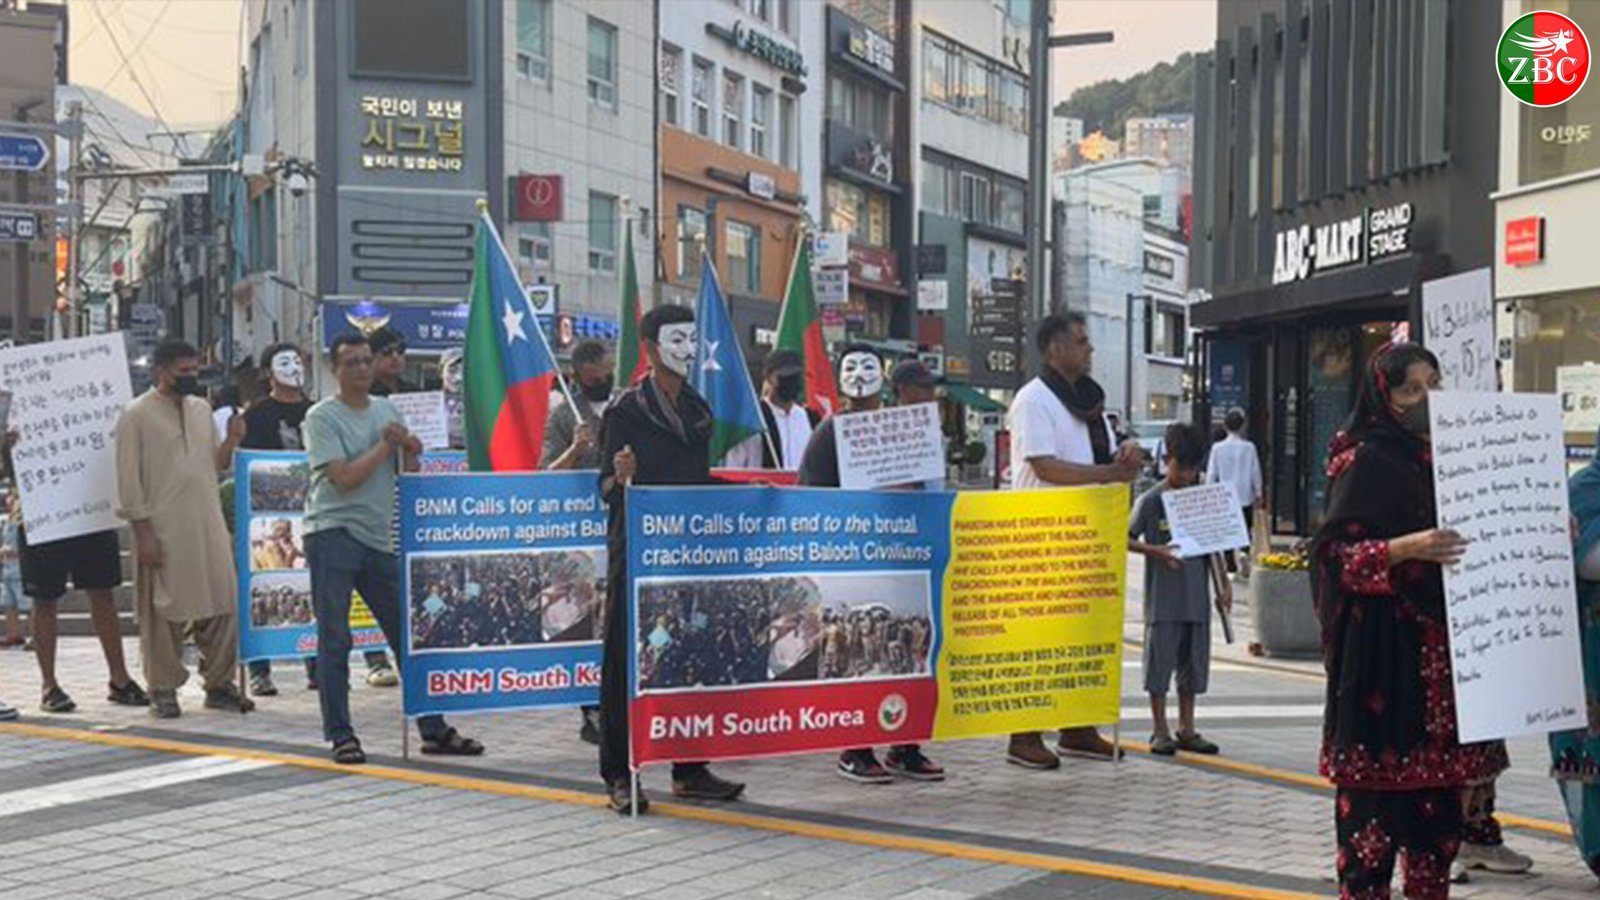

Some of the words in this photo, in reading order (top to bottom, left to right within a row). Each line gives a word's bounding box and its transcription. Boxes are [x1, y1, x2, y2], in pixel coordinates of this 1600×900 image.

[426, 99, 462, 119] 보낸
[362, 119, 463, 155] 시그널
[1370, 202, 1412, 233] GRAND
[1369, 228, 1408, 257] STAGE
[415, 498, 457, 517] BNM
[461, 496, 504, 516] Calls
[510, 496, 533, 514] for
[538, 499, 559, 513] an
[563, 494, 595, 512] end
[414, 523, 510, 544] crackdown
[513, 520, 577, 544] against
[580, 518, 608, 538] Bal
[642, 513, 685, 536] BNM
[689, 513, 735, 535] Calls
[738, 512, 762, 534] for
[766, 516, 787, 533] an
[790, 513, 819, 534] end
[823, 514, 841, 533] to
[844, 513, 871, 533] the
[1019, 515, 1056, 529] STARTED
[1065, 514, 1088, 527] HUGE
[956, 533, 1011, 547] CRACKDOWN
[1013, 531, 1047, 544] AGAINST
[1048, 530, 1063, 543] THE
[1064, 529, 1099, 542] BALOCH
[642, 544, 740, 566] crackdown
[743, 542, 805, 568] against
[808, 541, 861, 563] Baloch
[862, 540, 932, 562] Civilians
[951, 578, 1008, 592] CRACKDOWN
[952, 608, 988, 622] RELEASE
[989, 607, 1000, 620] OF
[1002, 605, 1017, 618] ALL
[1018, 603, 1044, 617] THOSE
[427, 670, 493, 697] BNM
[498, 667, 569, 692] South
[649, 713, 715, 740] BNM
[722, 708, 793, 737] South
[799, 706, 866, 730] Korea
